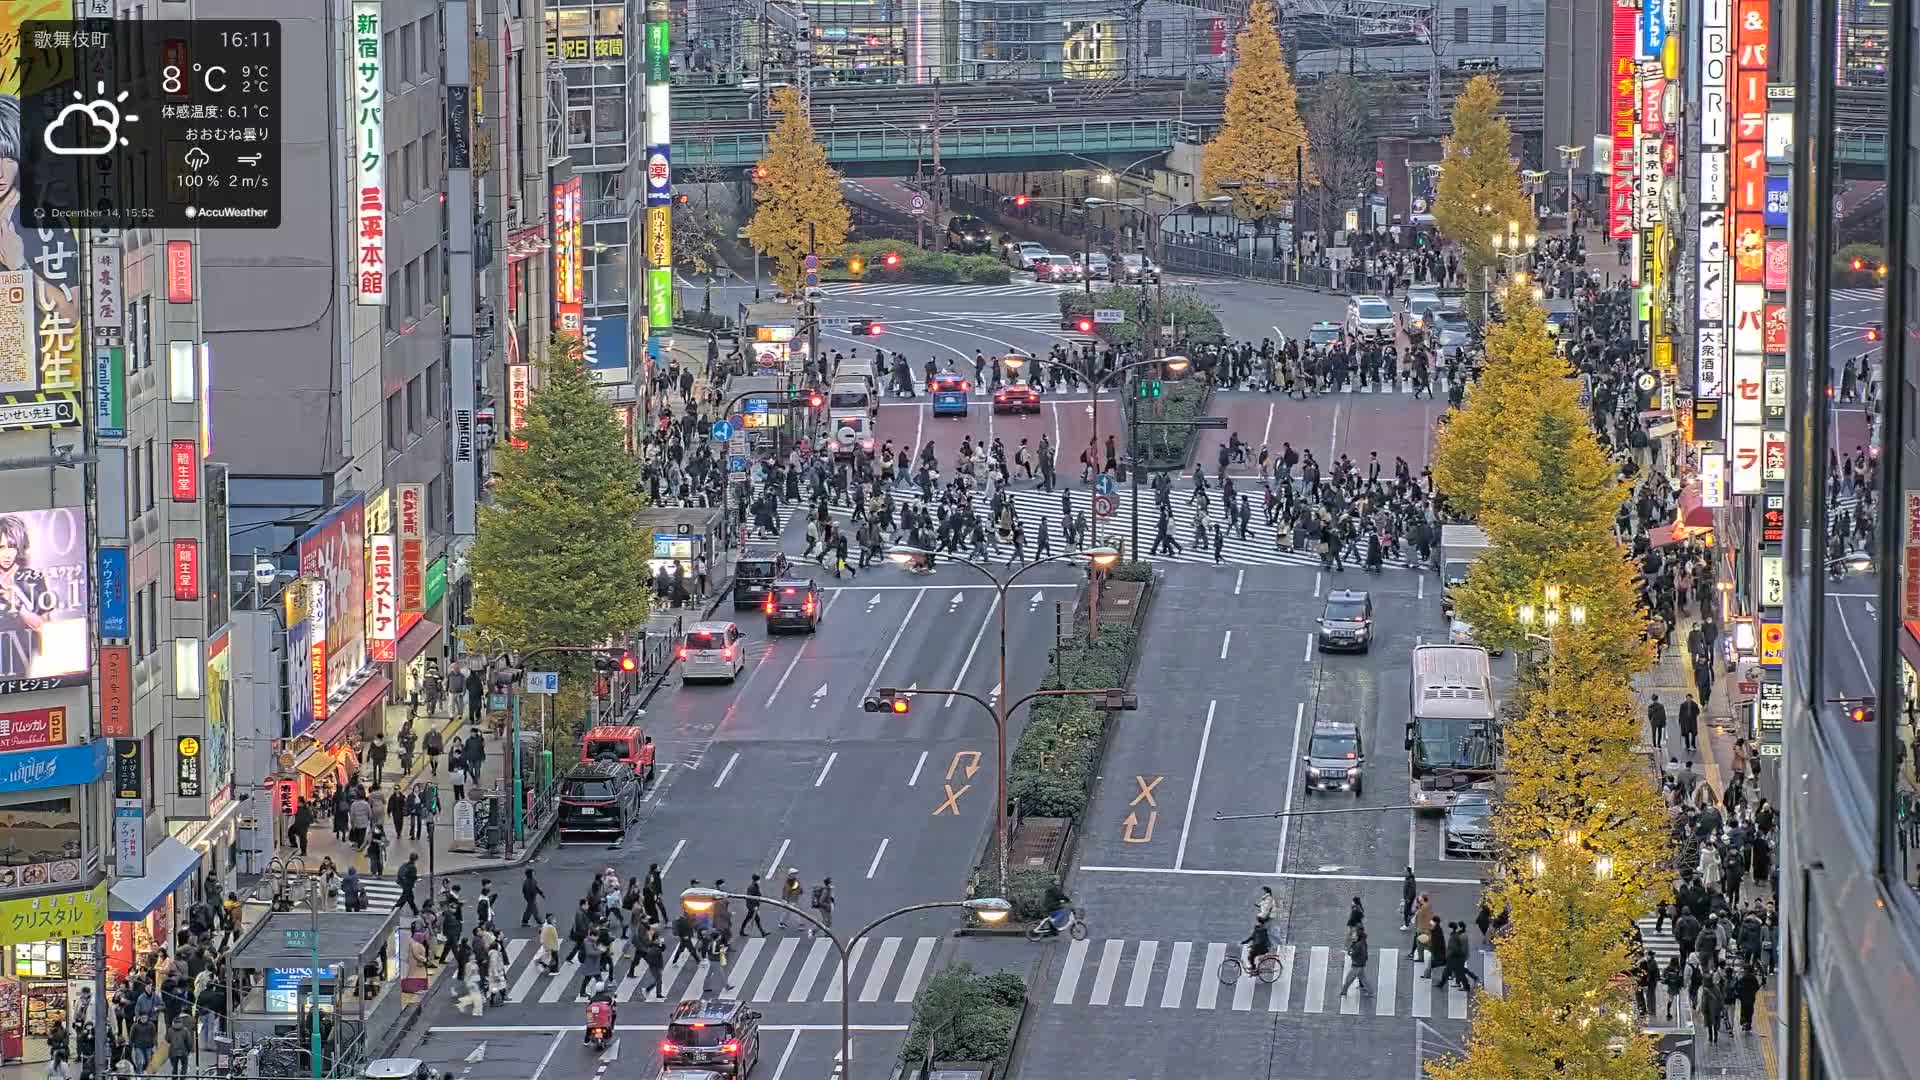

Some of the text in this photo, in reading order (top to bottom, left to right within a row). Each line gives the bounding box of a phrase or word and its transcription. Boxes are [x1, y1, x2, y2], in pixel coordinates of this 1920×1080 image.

[563, 40, 587, 57] 祝日
[595, 39, 622, 56] 夜間
[1648, 89, 1659, 121] アコム
[357, 14, 383, 294] 新宿サンパーク 三平本館
[651, 163, 666, 178] 薬
[653, 210, 665, 265] 肉汁水餃子
[653, 277, 666, 315] レイク
[100, 327, 117, 336] 3F
[1701, 331, 1715, 383] 大衆酒場
[98, 356, 110, 417] FamilyMart
[103, 558, 113, 608] ゲウチャイ
[375, 545, 392, 631] 三平ストア
[51, 714, 61, 739] 5F
[12, 907, 83, 931] クリスタル
